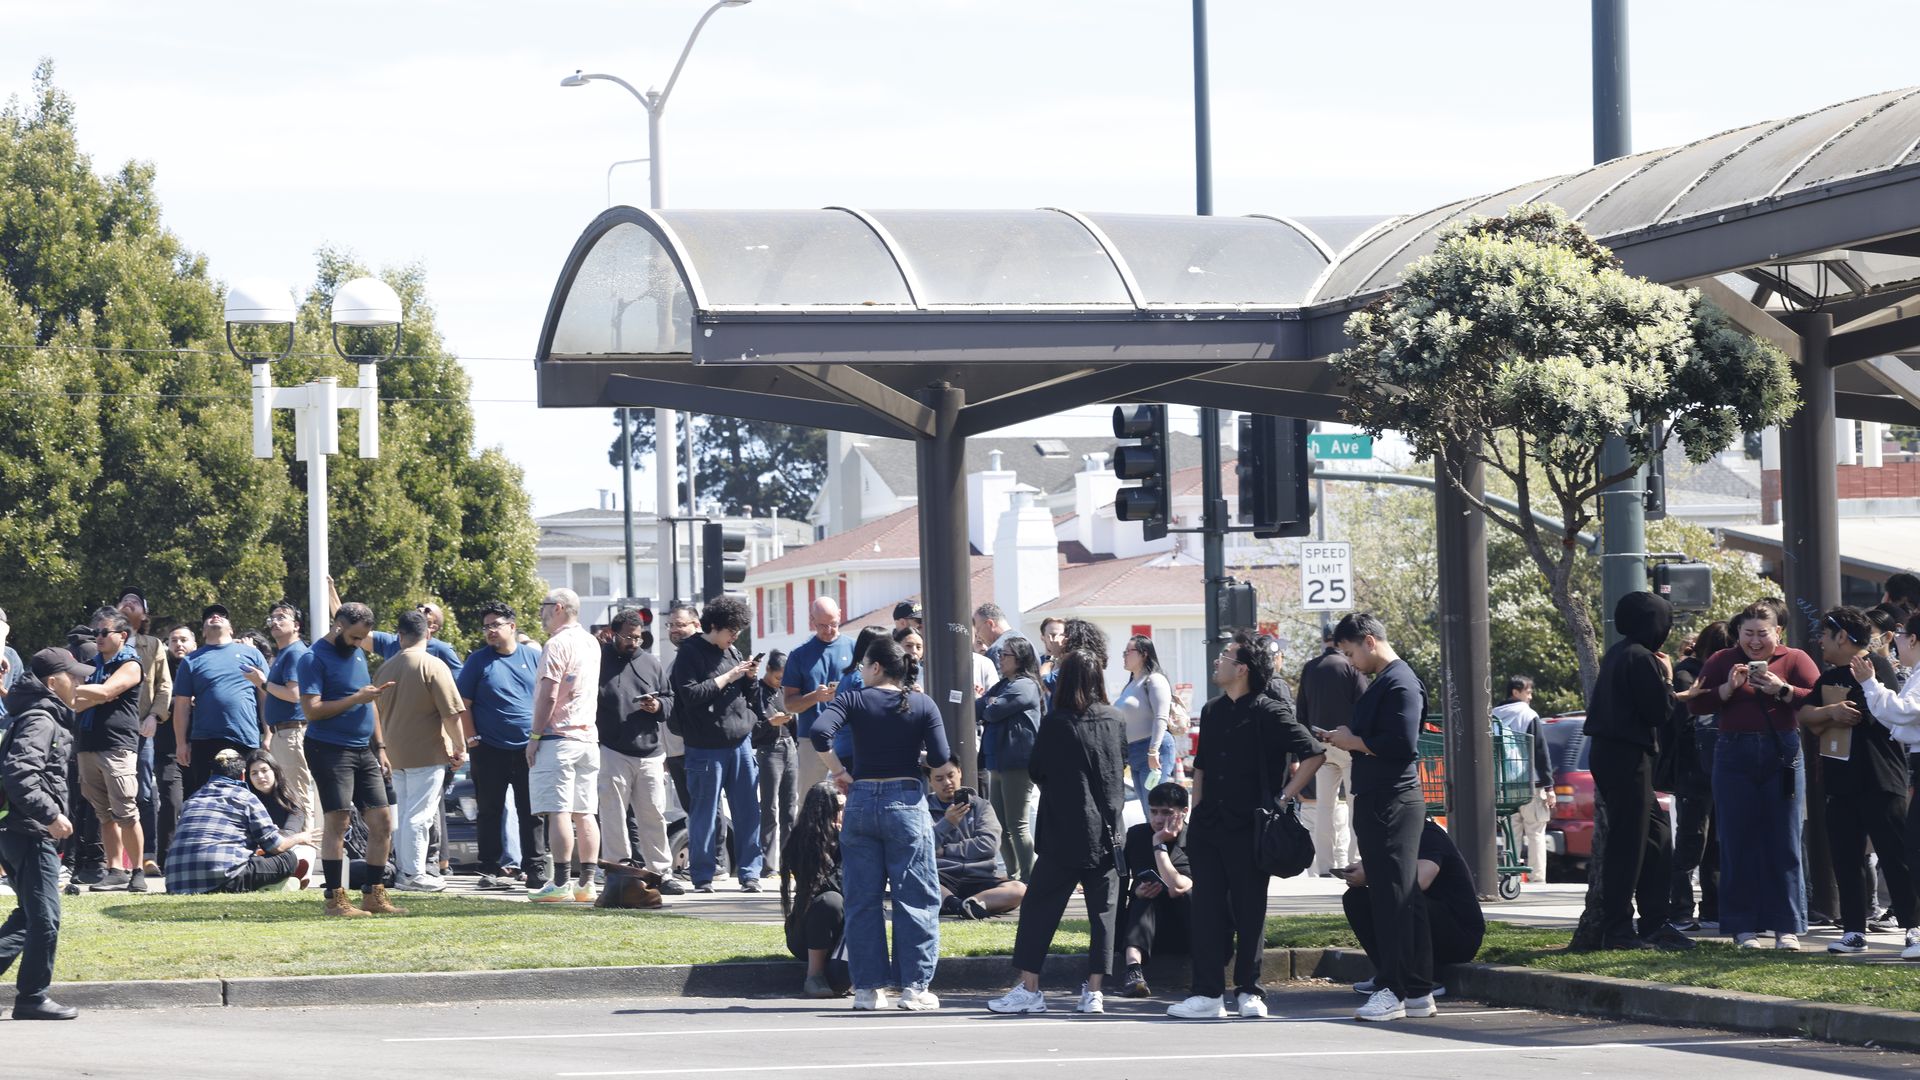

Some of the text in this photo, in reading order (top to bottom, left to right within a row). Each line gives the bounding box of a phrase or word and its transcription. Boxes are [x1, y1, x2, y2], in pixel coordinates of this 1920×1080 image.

[1331, 439, 1359, 454] Ave
[1305, 548, 1346, 559] SPEED
[1308, 563, 1343, 575] LIMIT
[1308, 579, 1346, 603] 25
